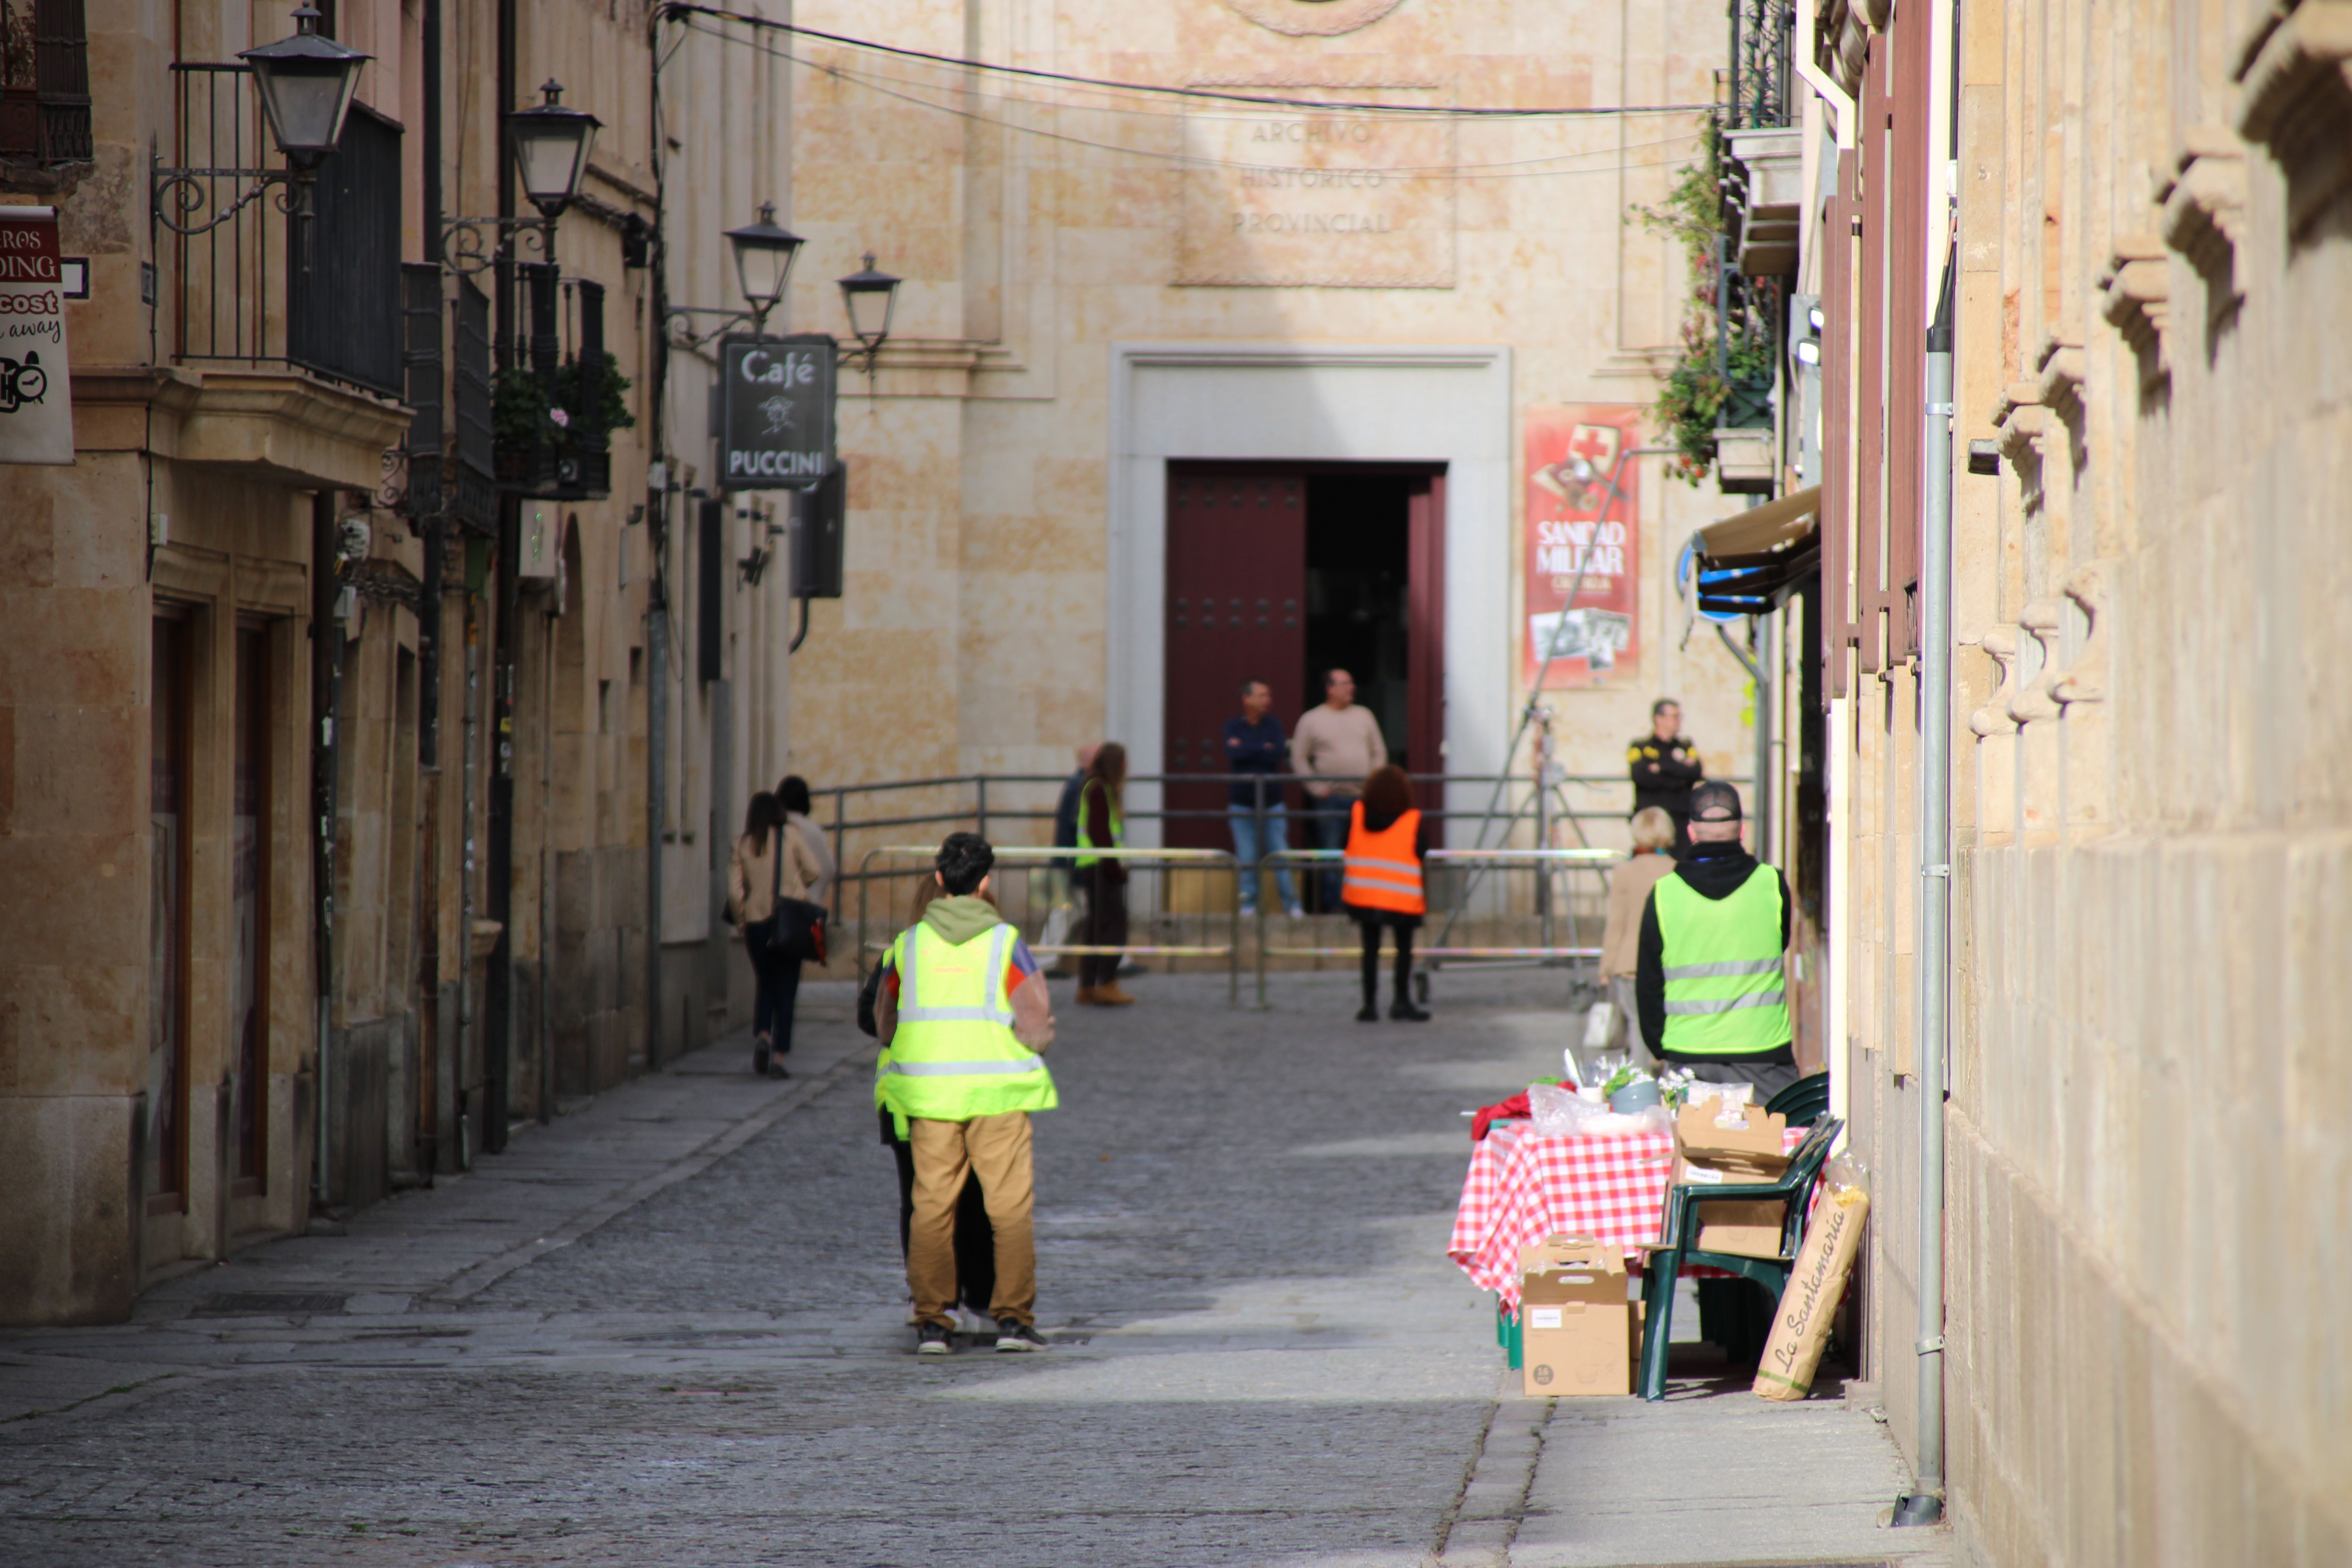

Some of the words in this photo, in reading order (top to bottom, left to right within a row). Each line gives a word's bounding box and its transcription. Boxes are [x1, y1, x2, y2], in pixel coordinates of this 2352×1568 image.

[1251, 122, 1370, 142] ARCHIVO
[1232, 213, 1390, 233] PROVINCIAL
[0, 230, 41, 249] ROS
[741, 350, 815, 389] Café
[730, 450, 822, 475] PUCCINI
[1537, 521, 1626, 545] SANIDAD
[1536, 545, 1624, 573] MILITAR
[1775, 1342, 1797, 1373] La
[1788, 1212, 1844, 1337] Santamaría
